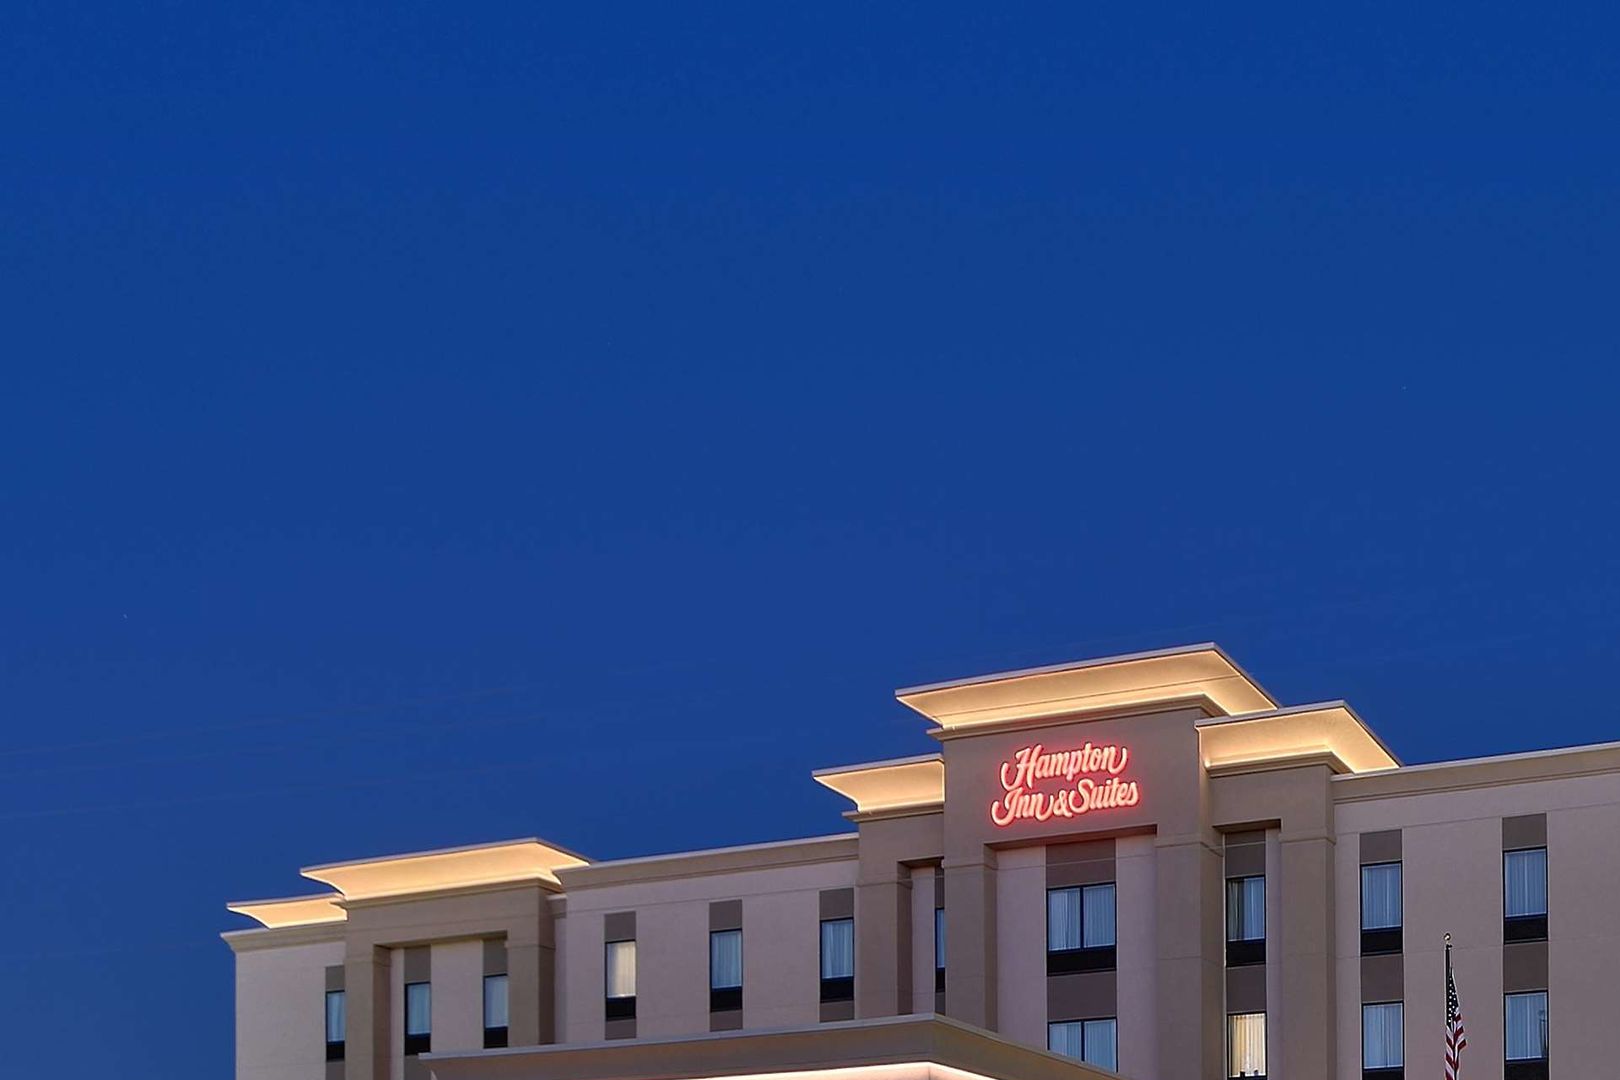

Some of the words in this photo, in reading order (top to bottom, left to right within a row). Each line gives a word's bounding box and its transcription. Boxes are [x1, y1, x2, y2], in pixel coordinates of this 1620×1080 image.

[1001, 742, 1128, 791] Hampton
[992, 787, 1054, 826] Inn
[1053, 790, 1072, 818] &
[1069, 777, 1139, 813] Suites
